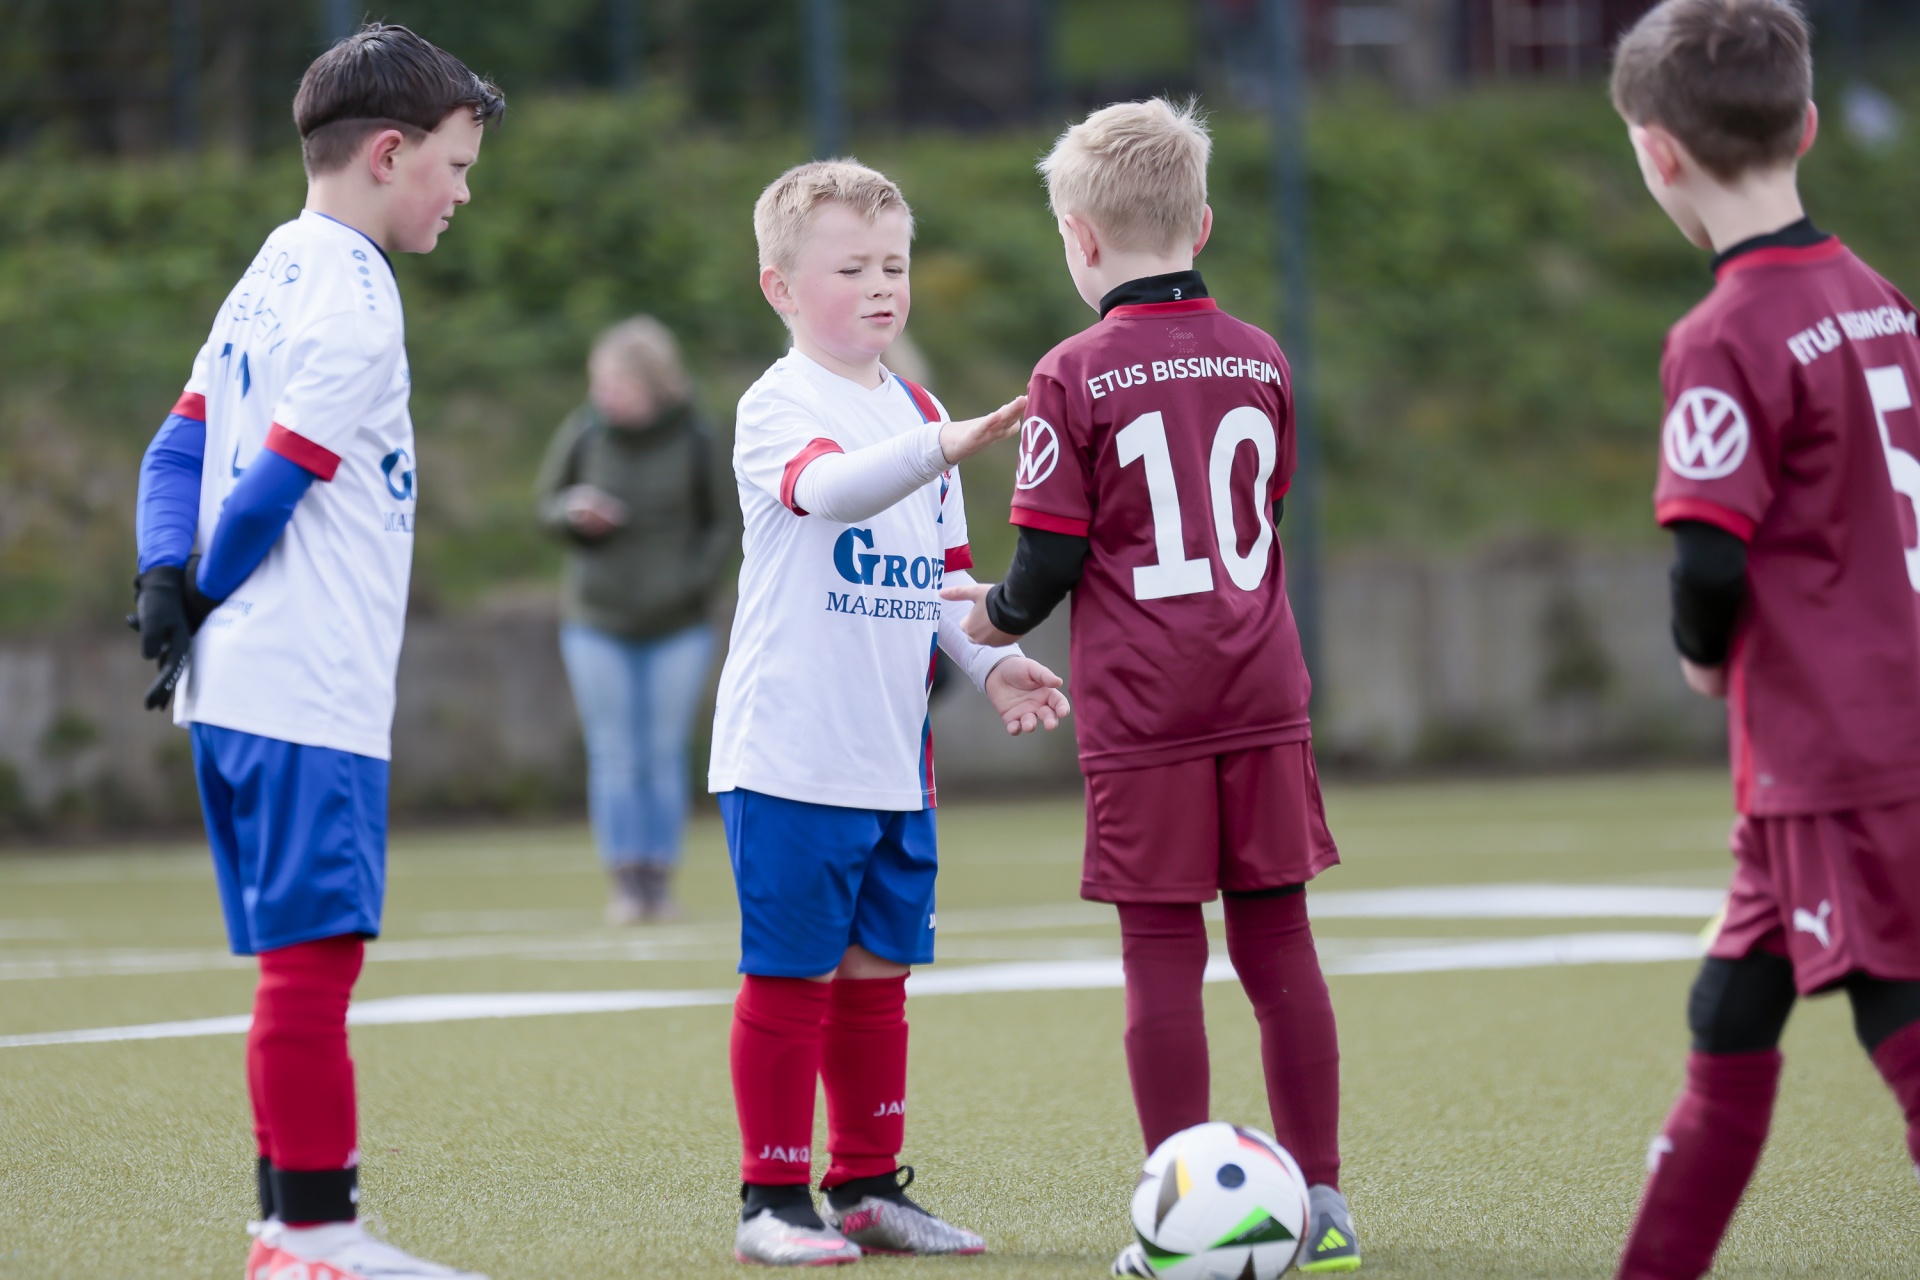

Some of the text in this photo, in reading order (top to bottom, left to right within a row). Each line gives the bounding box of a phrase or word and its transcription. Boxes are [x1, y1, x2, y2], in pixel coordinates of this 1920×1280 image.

[1087, 356, 1282, 400] ETUS BISSINGHEIM
[1115, 405, 1277, 601] 10
[759, 1144, 810, 1164] JAKO
